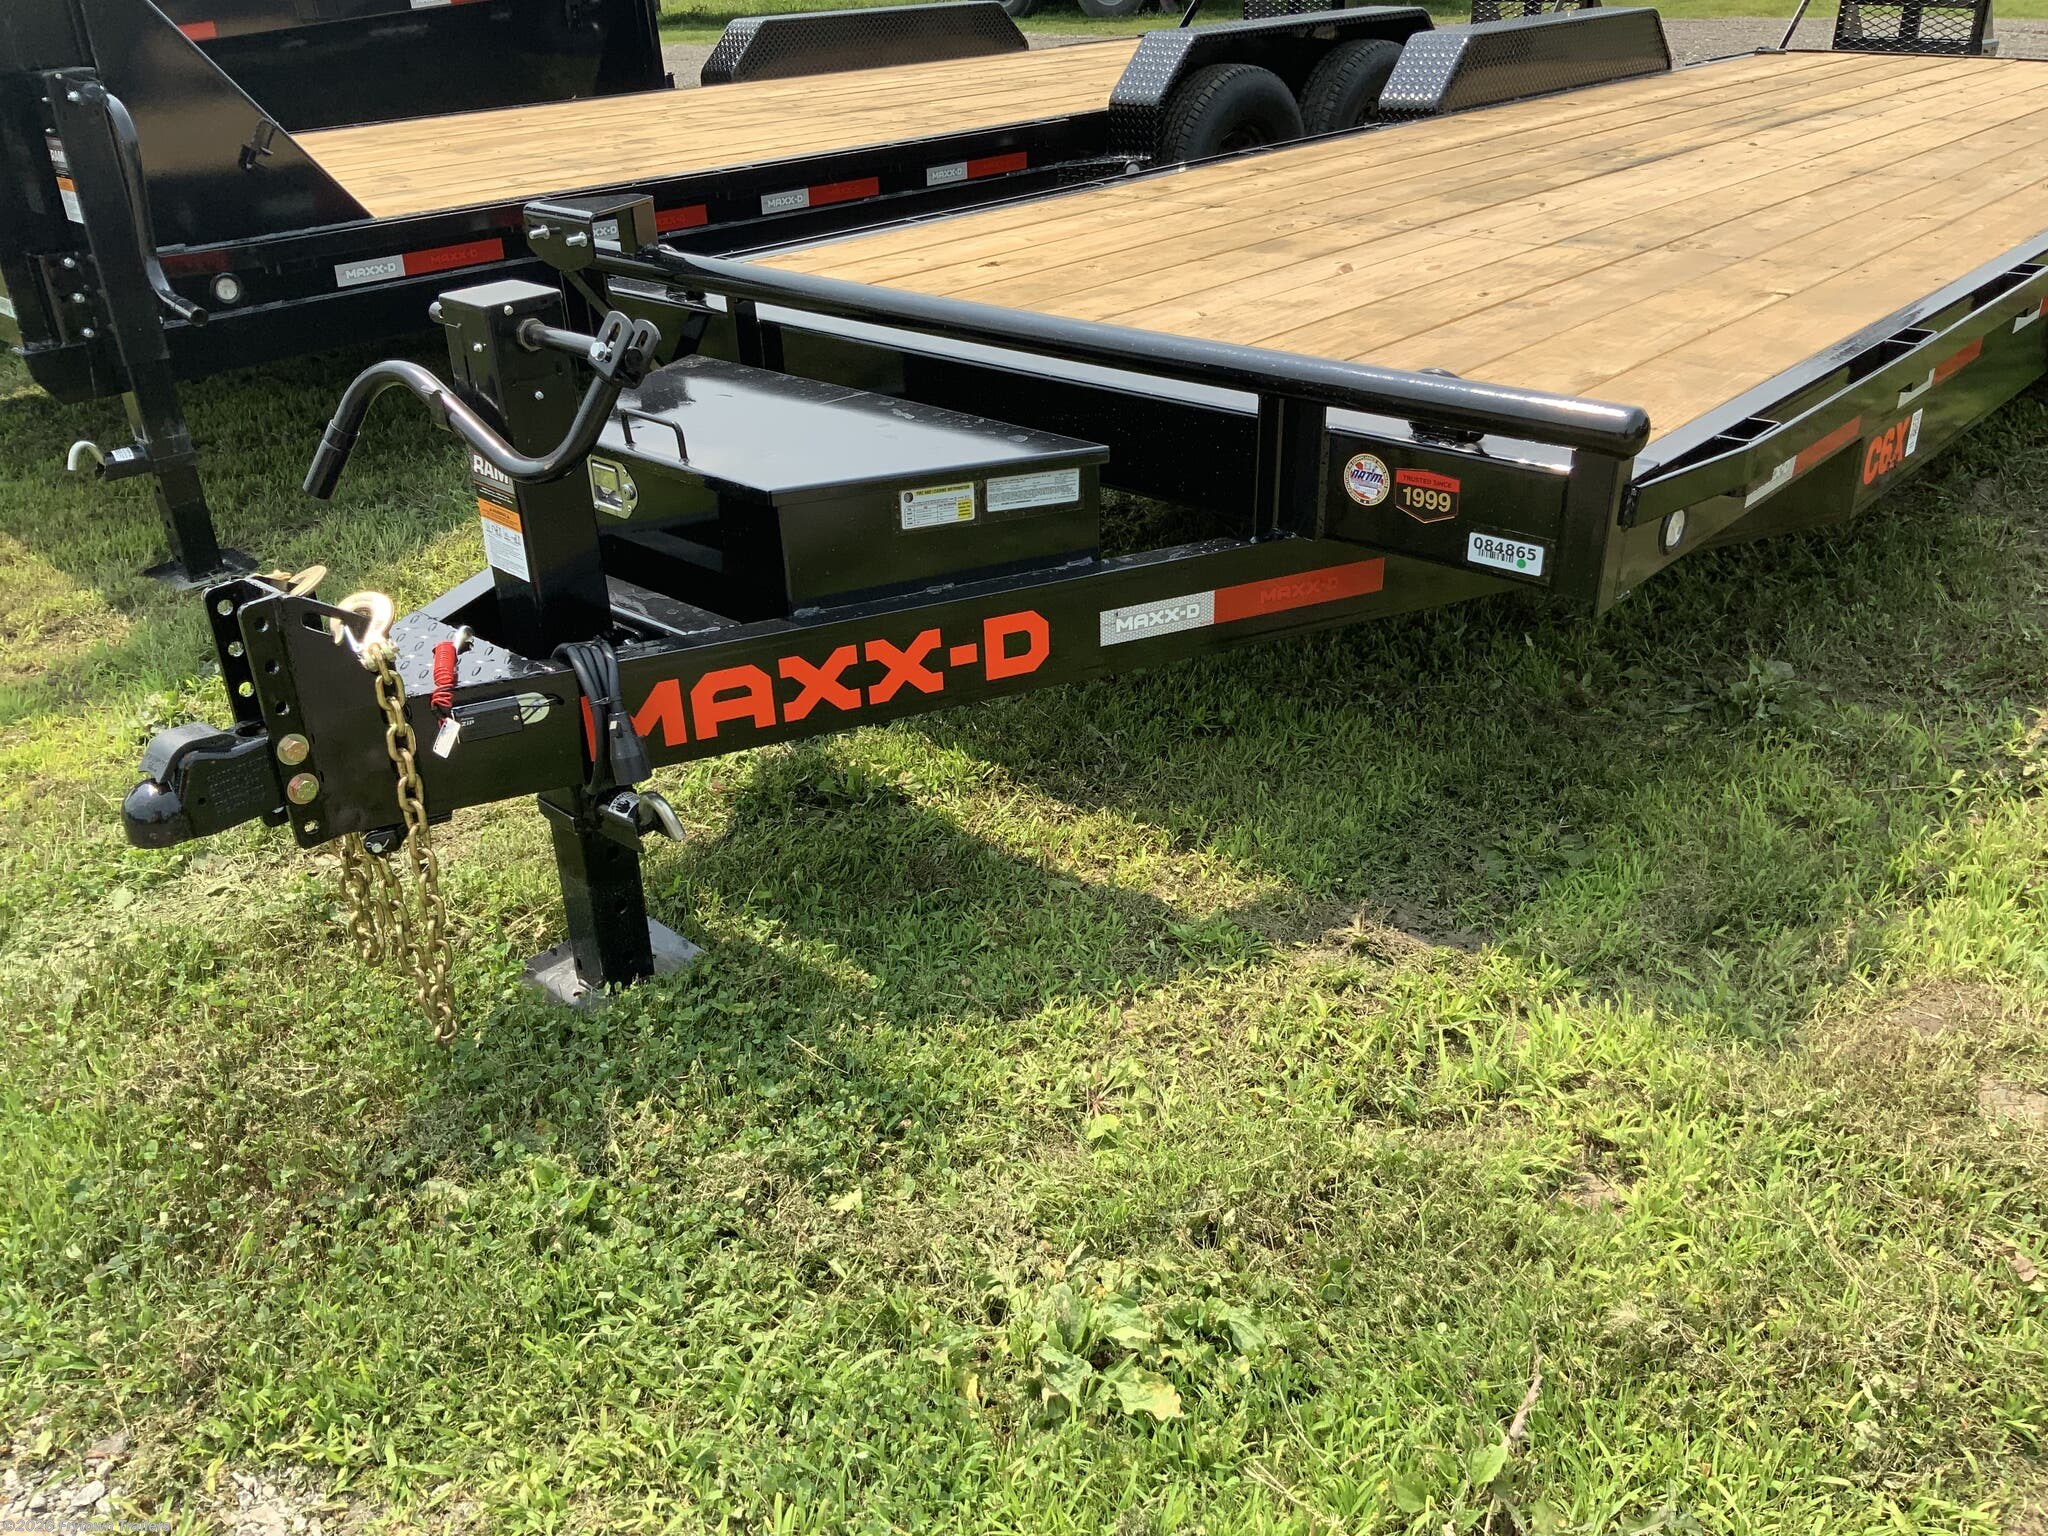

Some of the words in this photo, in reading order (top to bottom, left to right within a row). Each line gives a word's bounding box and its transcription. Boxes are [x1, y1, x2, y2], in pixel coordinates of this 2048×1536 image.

[932, 168, 963, 180] MAXX-D
[767, 194, 803, 209] MAXX-D
[594, 225, 617, 237] XX-D
[345, 262, 396, 279] MAXX-D
[1863, 415, 1911, 486] C6X
[1402, 475, 1432, 485] TRUSTED
[1434, 479, 1453, 489] SINCE
[1403, 486, 1451, 512] 1999
[1473, 537, 1537, 561] 084865
[1260, 576, 1339, 603] MAXX-D
[1115, 603, 1200, 633] MAXX-D
[580, 610, 1050, 762] MAXX-D
